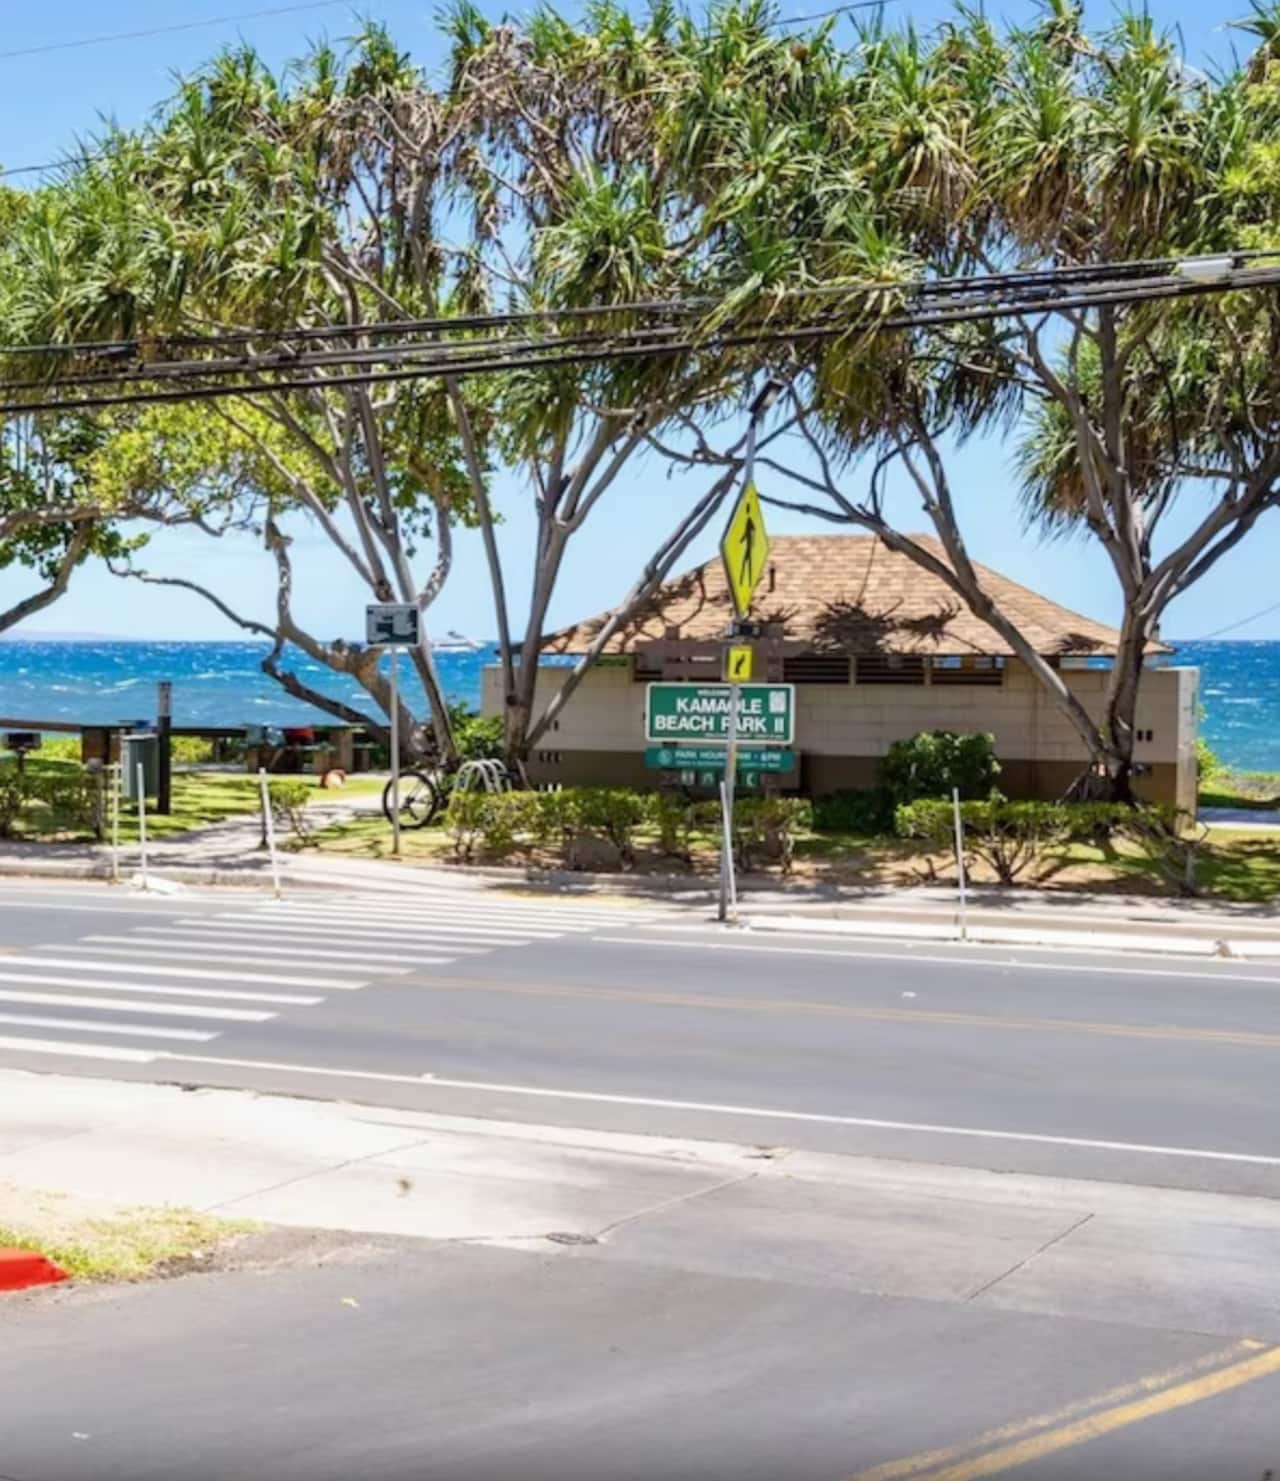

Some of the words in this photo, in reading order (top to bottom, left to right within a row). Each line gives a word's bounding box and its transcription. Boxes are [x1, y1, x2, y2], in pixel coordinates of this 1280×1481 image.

[655, 714, 715, 731] BEACH
[721, 716, 767, 733] PARK
[774, 717, 785, 733] II
